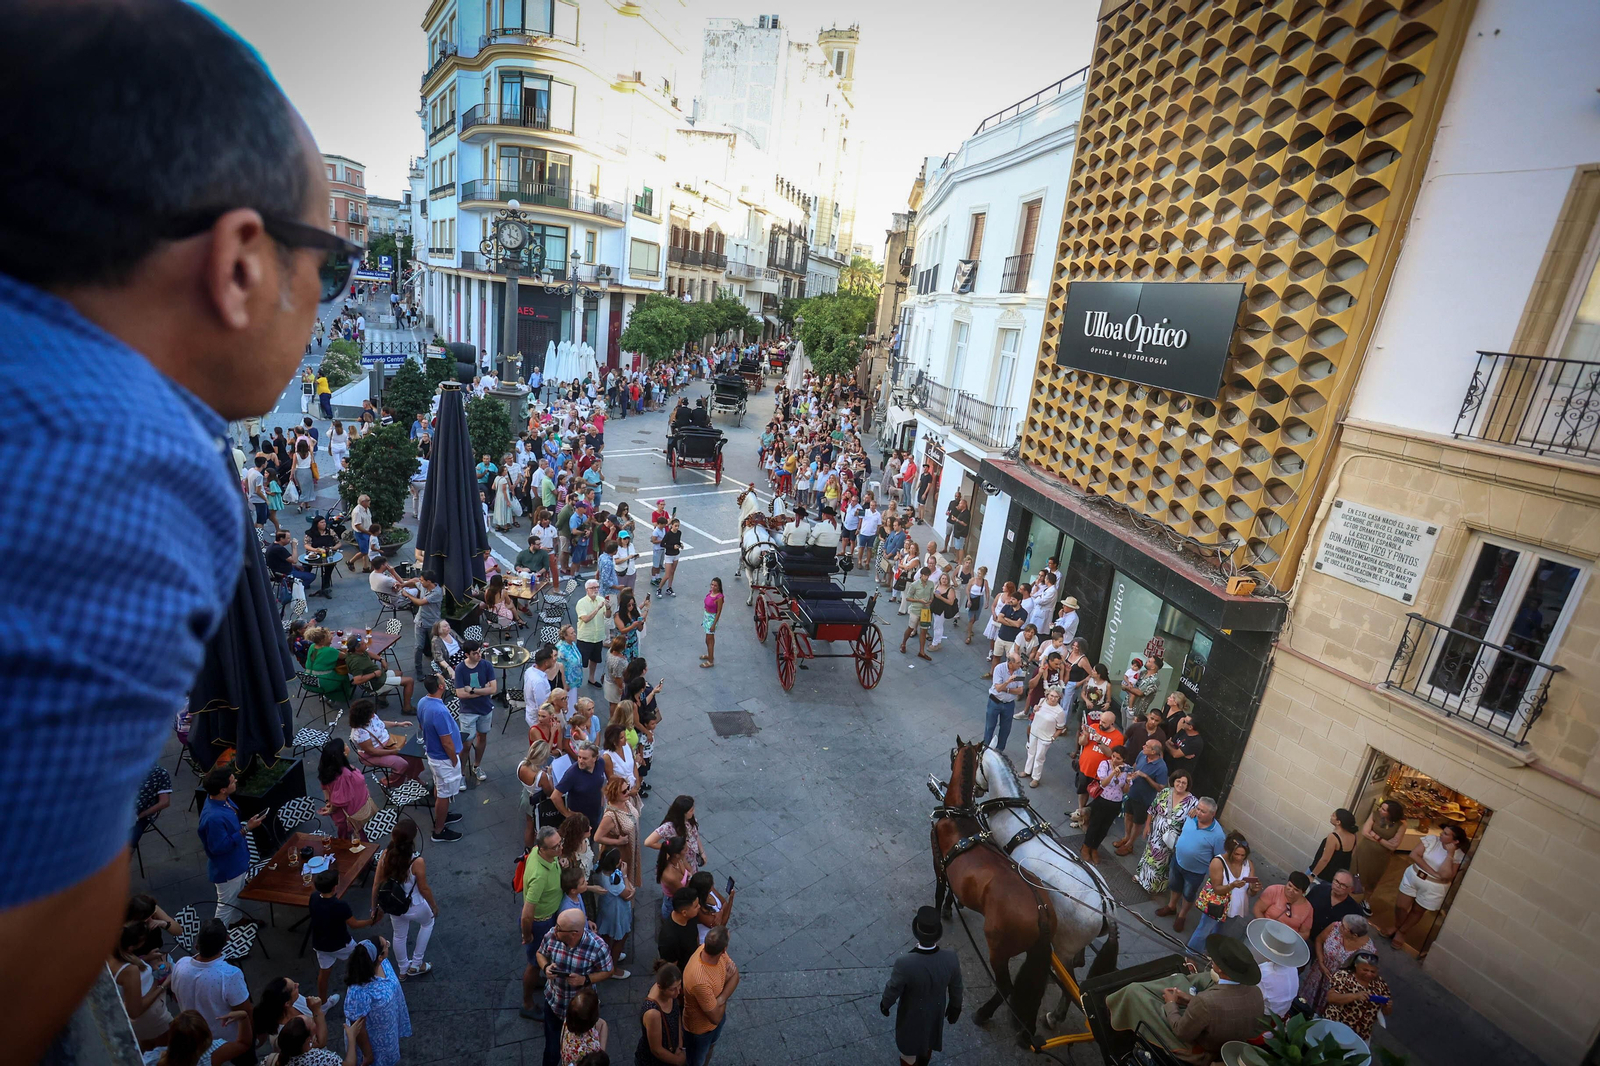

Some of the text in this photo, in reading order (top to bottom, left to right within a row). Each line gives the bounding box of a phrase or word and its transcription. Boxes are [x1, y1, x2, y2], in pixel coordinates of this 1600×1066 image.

[1090, 346, 1113, 357] ÓPTICA
[1122, 352, 1168, 366] AUDIOLOGÍA
[1341, 514, 1365, 524] DICIEMBRE
[1395, 529, 1421, 540] EMINENTE
[1329, 532, 1342, 542] DON
[1342, 536, 1369, 551] ANTONIO
[1370, 545, 1385, 556] VICO
[1386, 550, 1393, 558] Y
[1356, 533, 1374, 542] ESCENA
[1387, 534, 1404, 543] GLORIA
[1335, 547, 1351, 555] HONRAR
[1358, 554, 1377, 564] MEMORIA
[1325, 550, 1354, 564] AYUNTAMIENTO
[1396, 574, 1412, 583] MARZO
